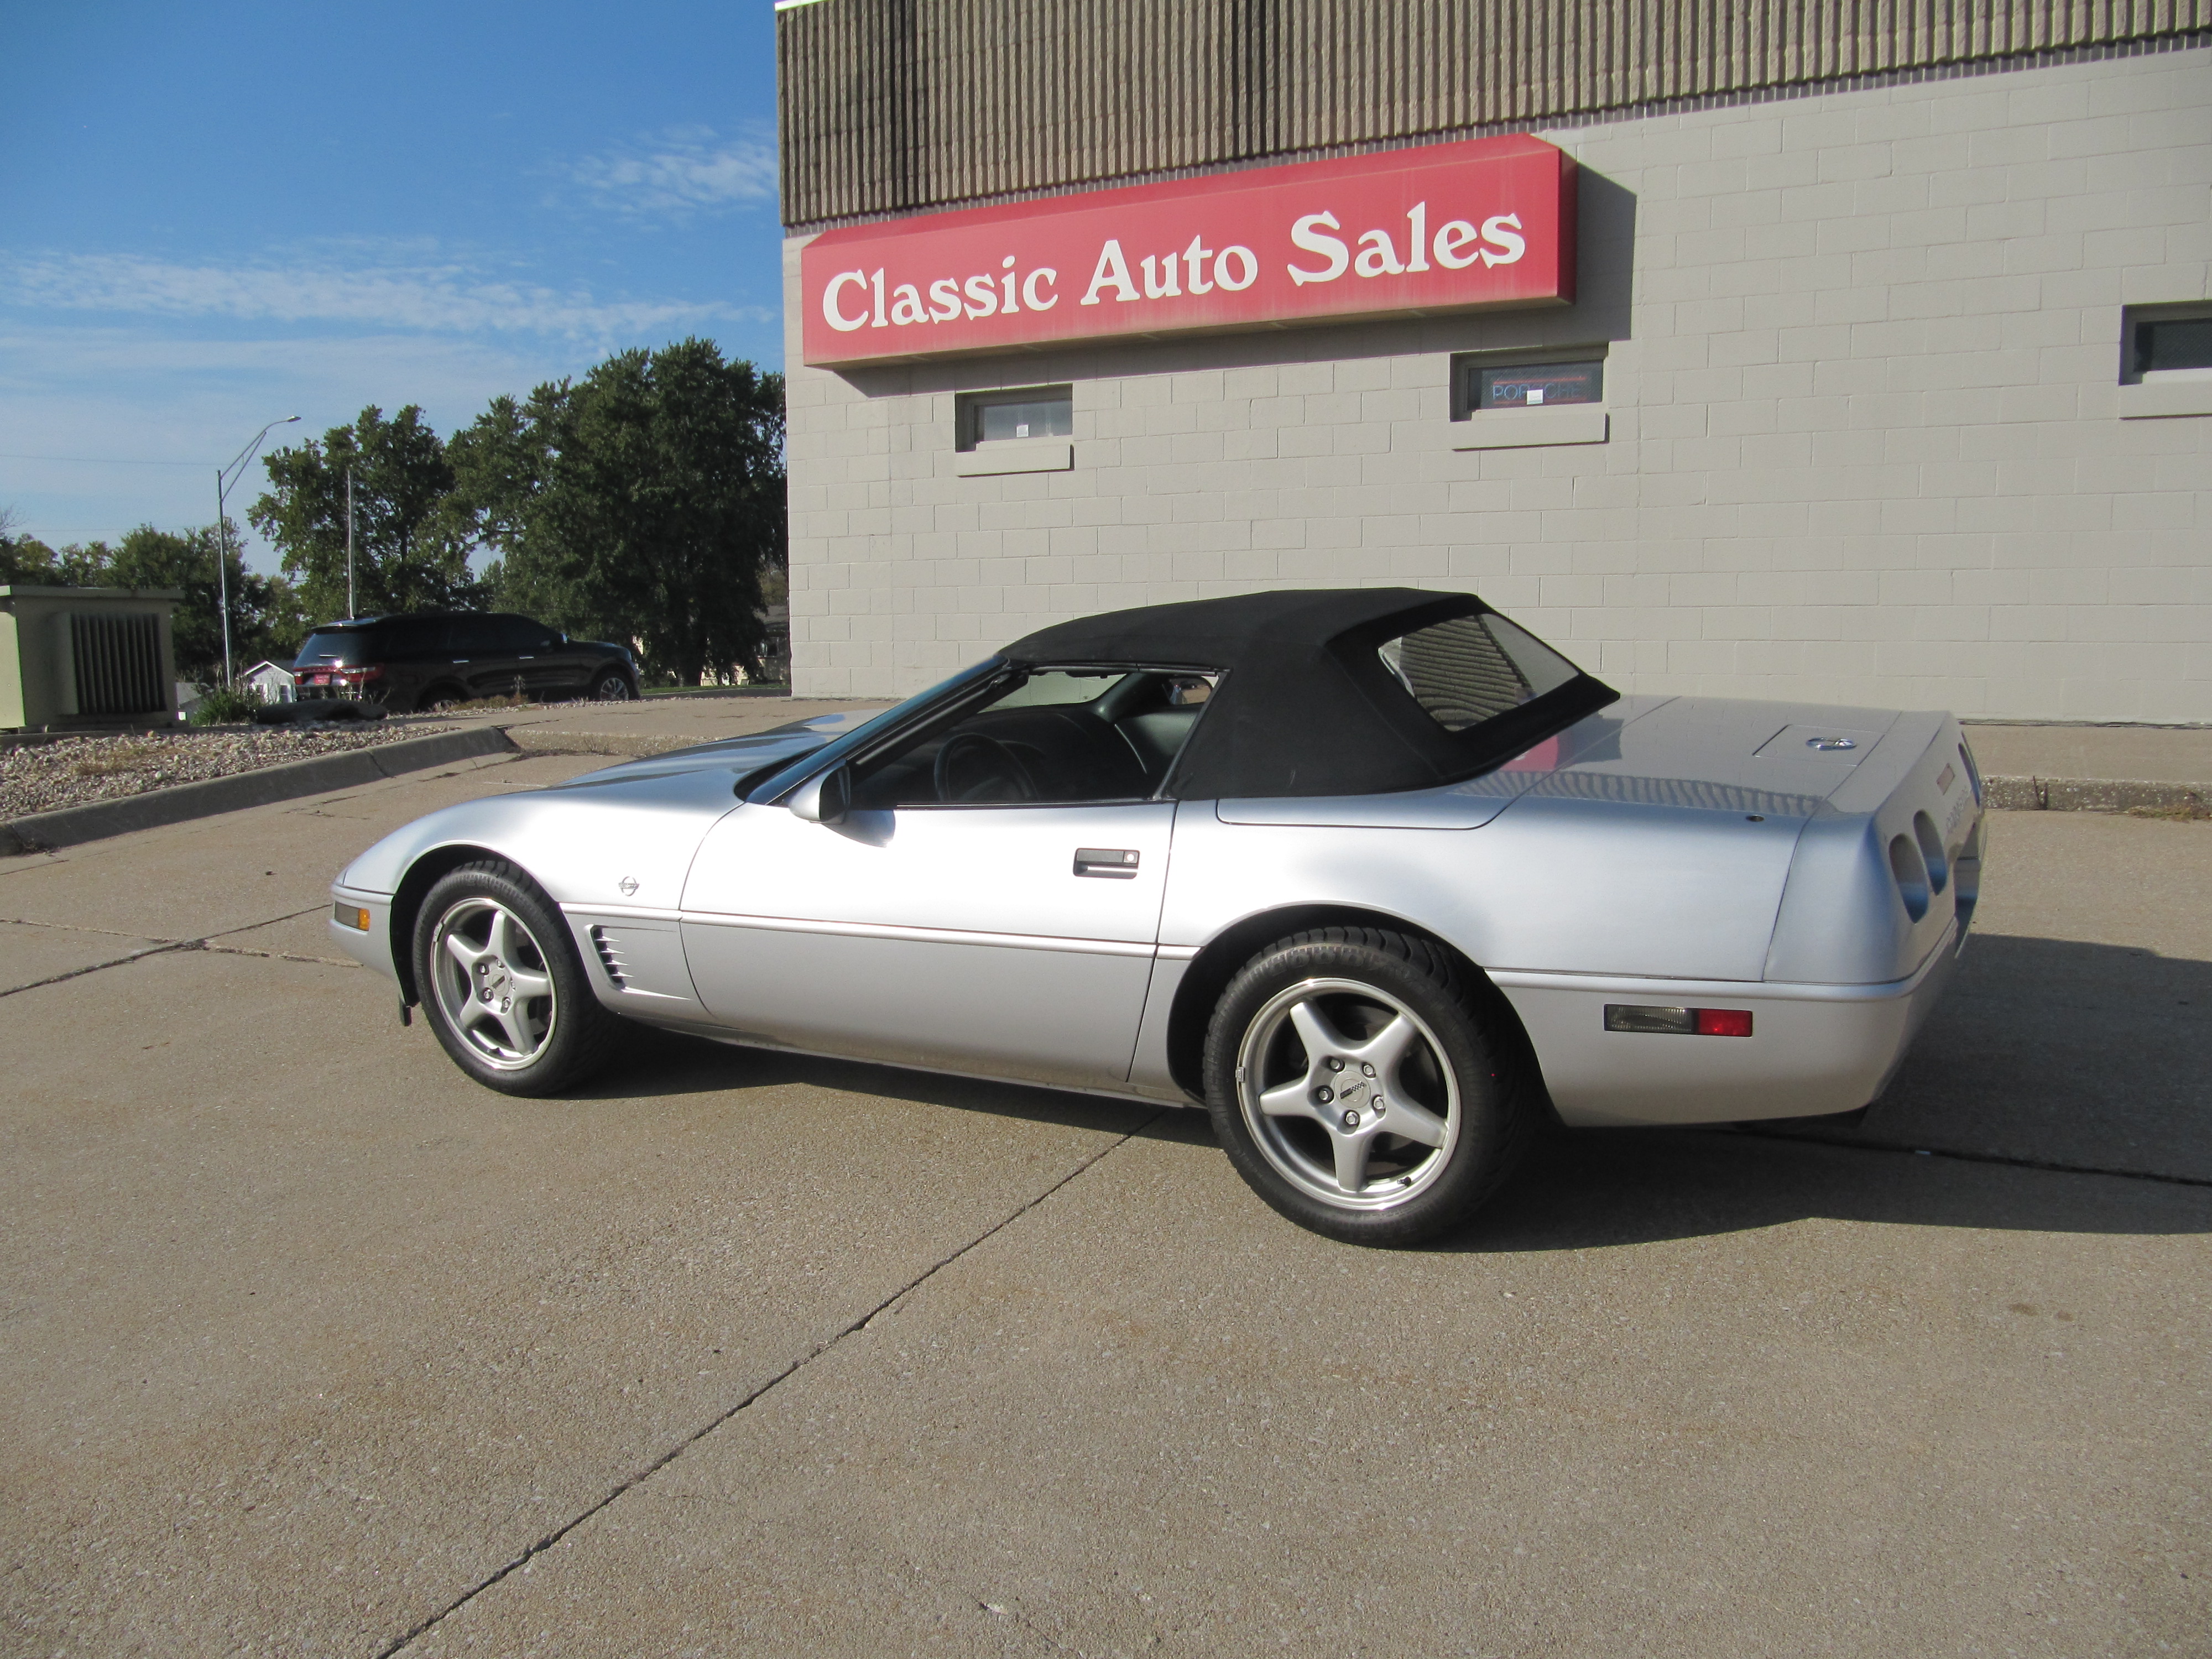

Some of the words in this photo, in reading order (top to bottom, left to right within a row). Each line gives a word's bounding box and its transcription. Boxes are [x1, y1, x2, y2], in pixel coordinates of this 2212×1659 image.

[822, 254, 1059, 331] Classic
[1079, 235, 1259, 305] Auto
[1287, 201, 1526, 286] Sales
[1493, 383, 1582, 400] PORCHE
